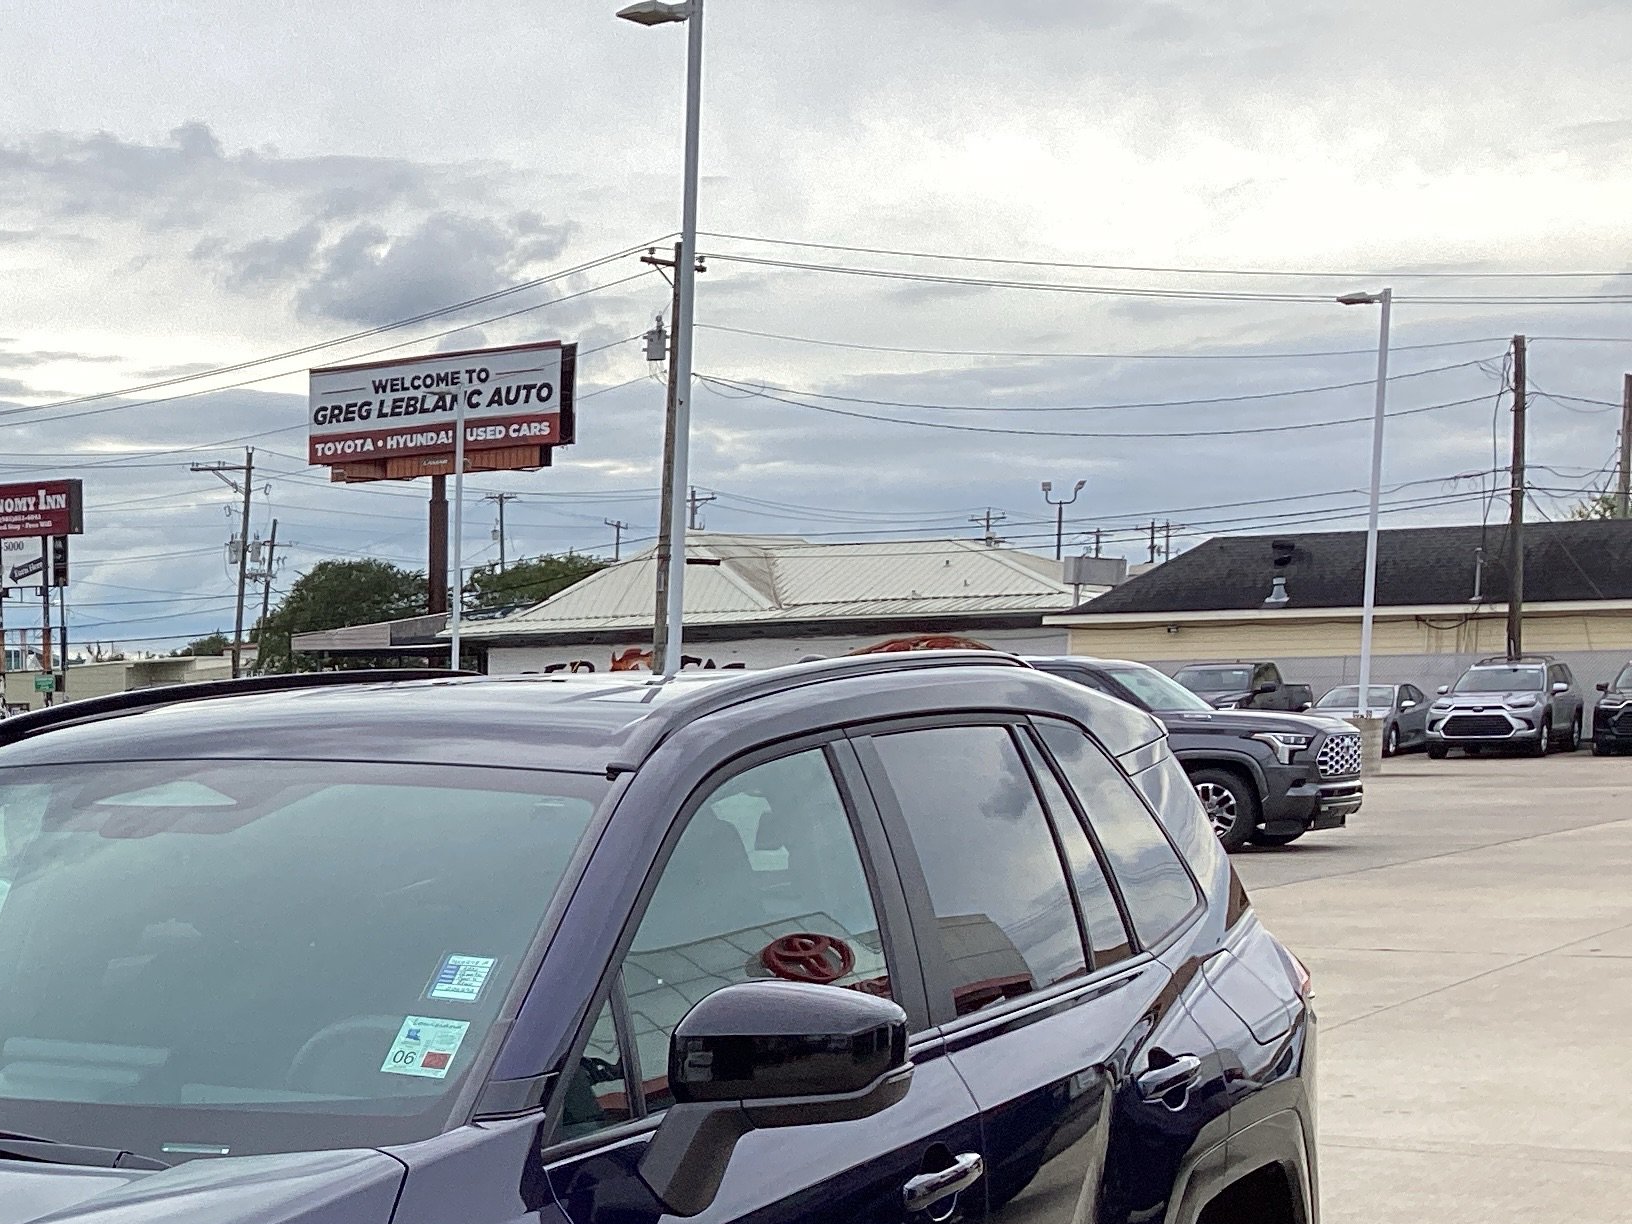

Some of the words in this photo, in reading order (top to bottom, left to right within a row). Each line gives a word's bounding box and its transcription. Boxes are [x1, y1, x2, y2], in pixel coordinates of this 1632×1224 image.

[372, 369, 461, 395] WELCOME
[467, 368, 489, 385] TO
[313, 401, 372, 426] GREG
[486, 382, 553, 408] AUTO
[315, 438, 374, 457] TOYOTA
[386, 430, 453, 450] HYUNDAI
[466, 425, 506, 441] USED
[509, 422, 550, 438] CARS
[393, 1050, 417, 1065] 06
